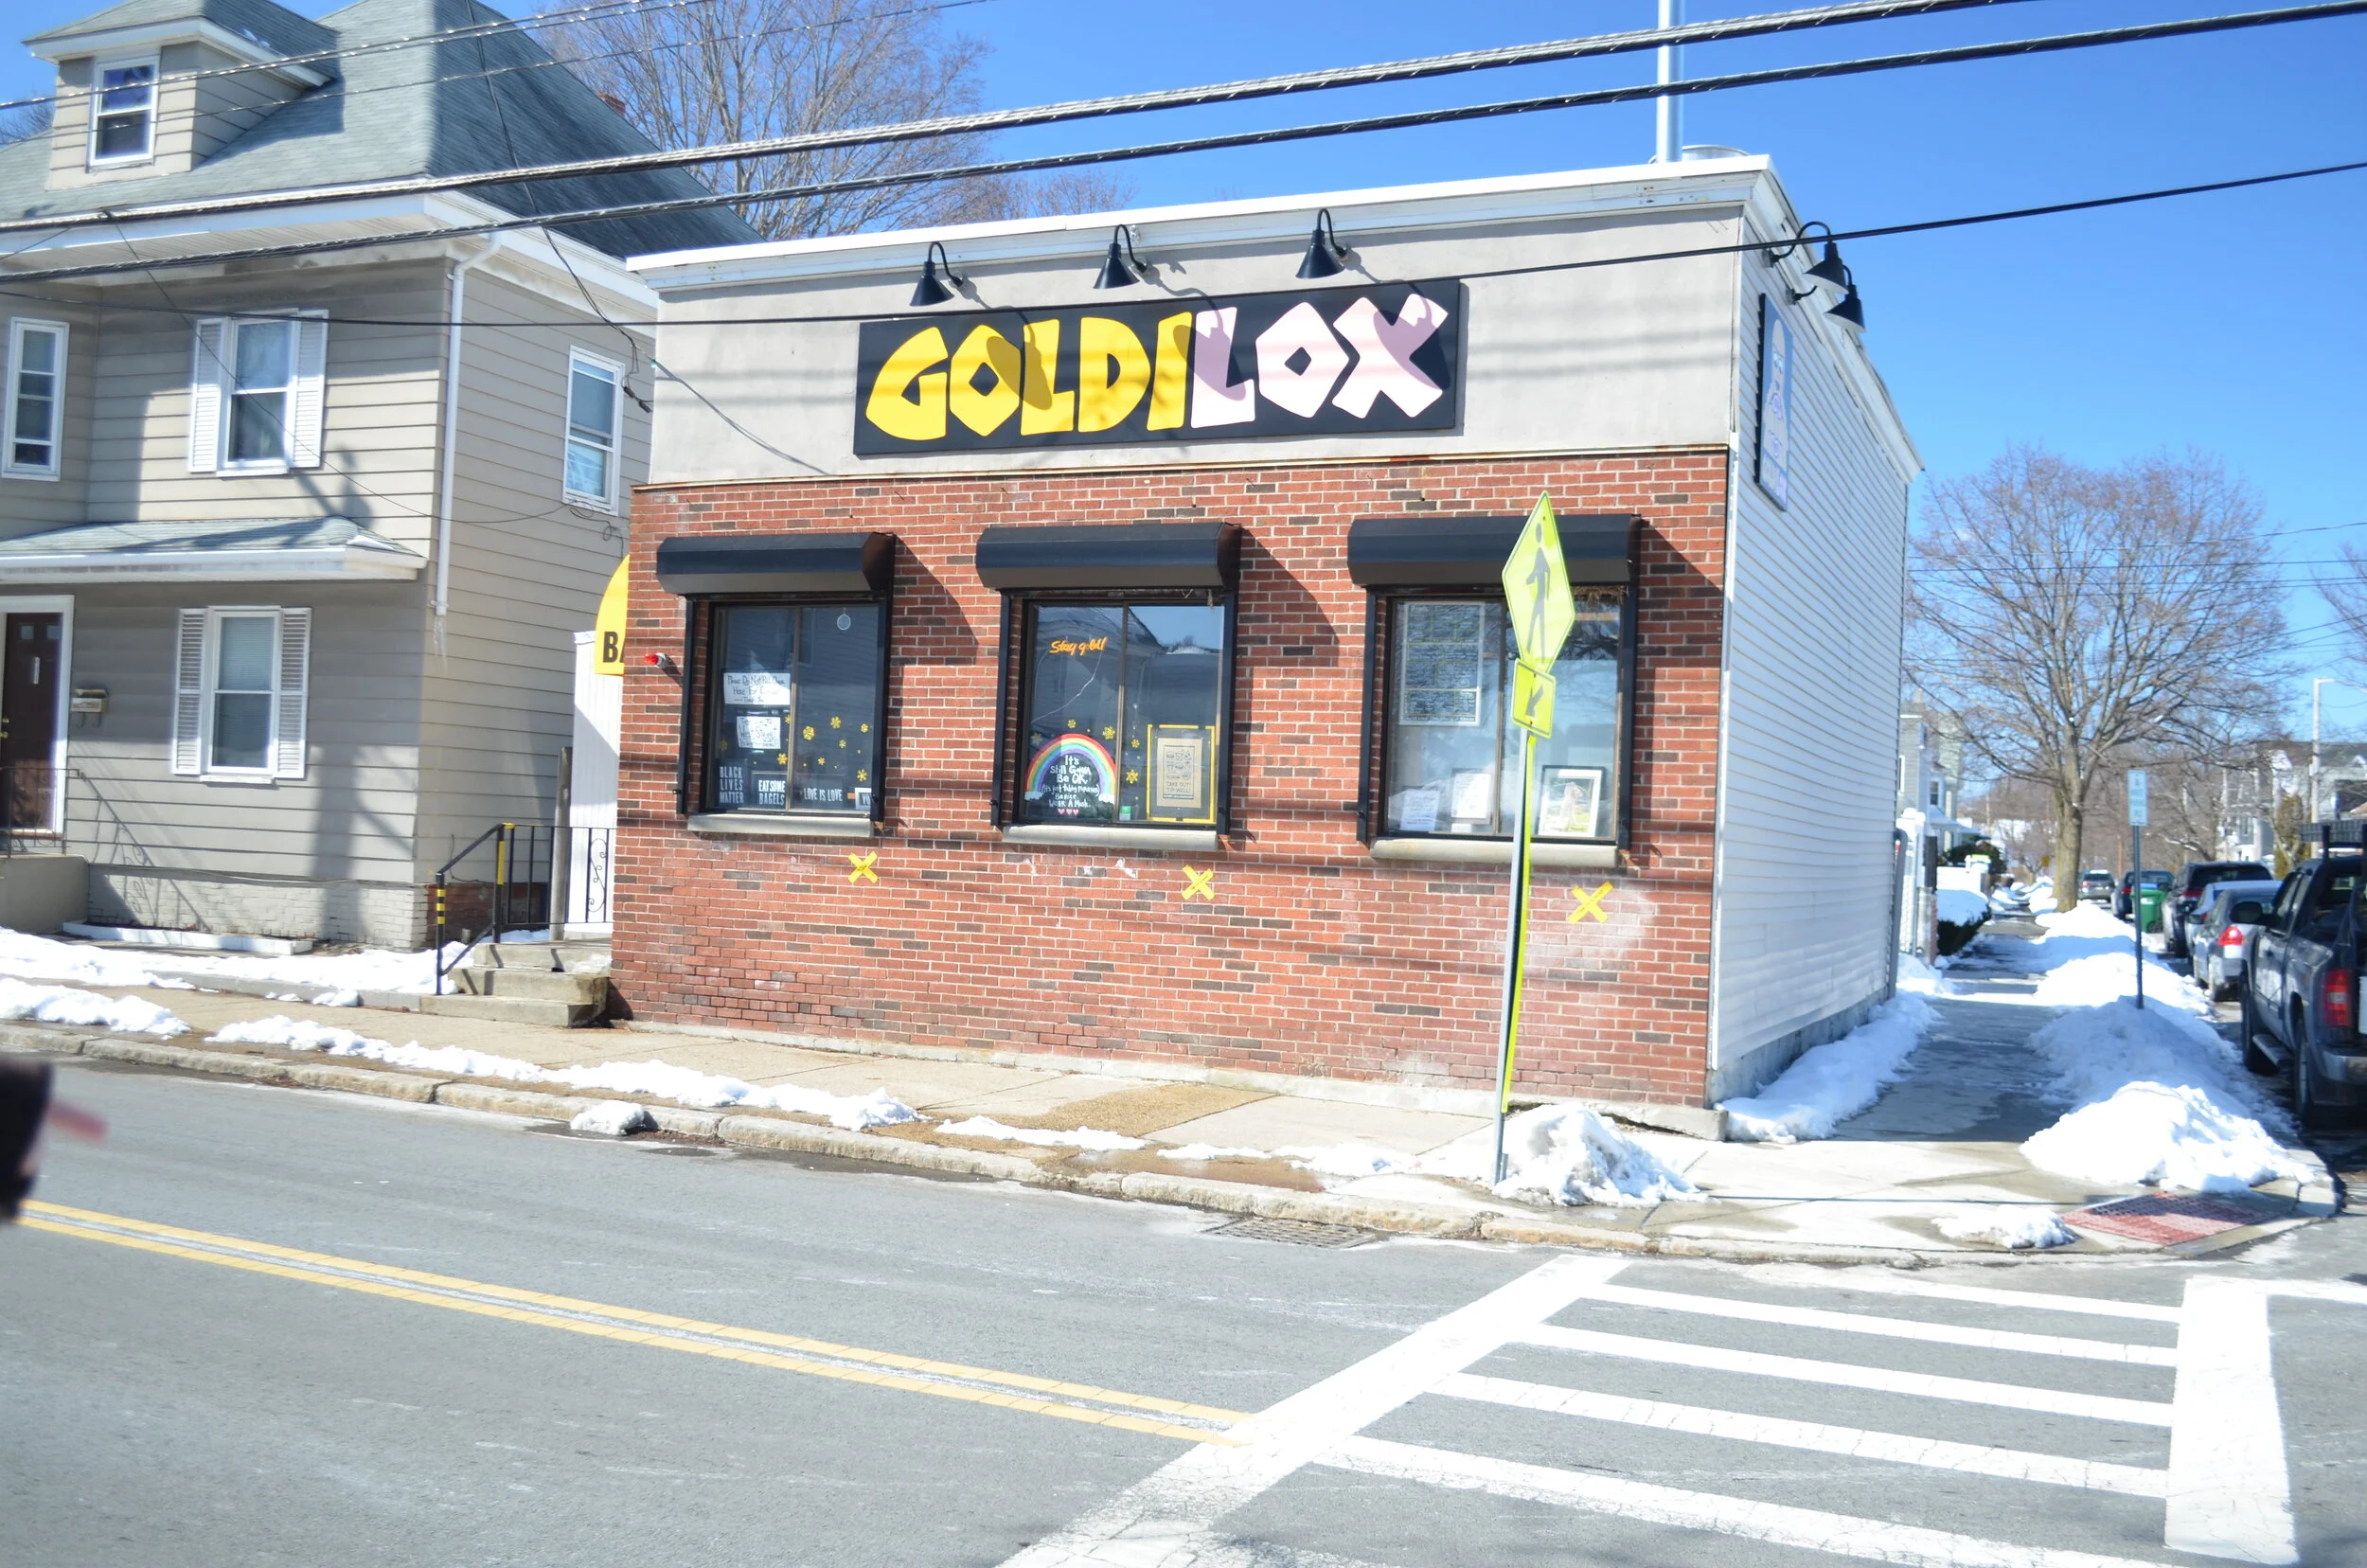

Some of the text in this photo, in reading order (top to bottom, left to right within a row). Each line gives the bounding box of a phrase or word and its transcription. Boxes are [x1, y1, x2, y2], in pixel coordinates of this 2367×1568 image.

[865, 294, 1449, 441] GOLDILOX
[1064, 755, 1080, 766] It's
[720, 766, 743, 779] BLACK
[1050, 765, 1067, 775] Still
[720, 778, 743, 792] LIVES
[1057, 774, 1070, 783] Be
[758, 779, 786, 793] EAT SOME
[720, 791, 744, 804] MATTER
[759, 793, 786, 806] BAGELS
[804, 788, 843, 802] LOVE IS LOVE
